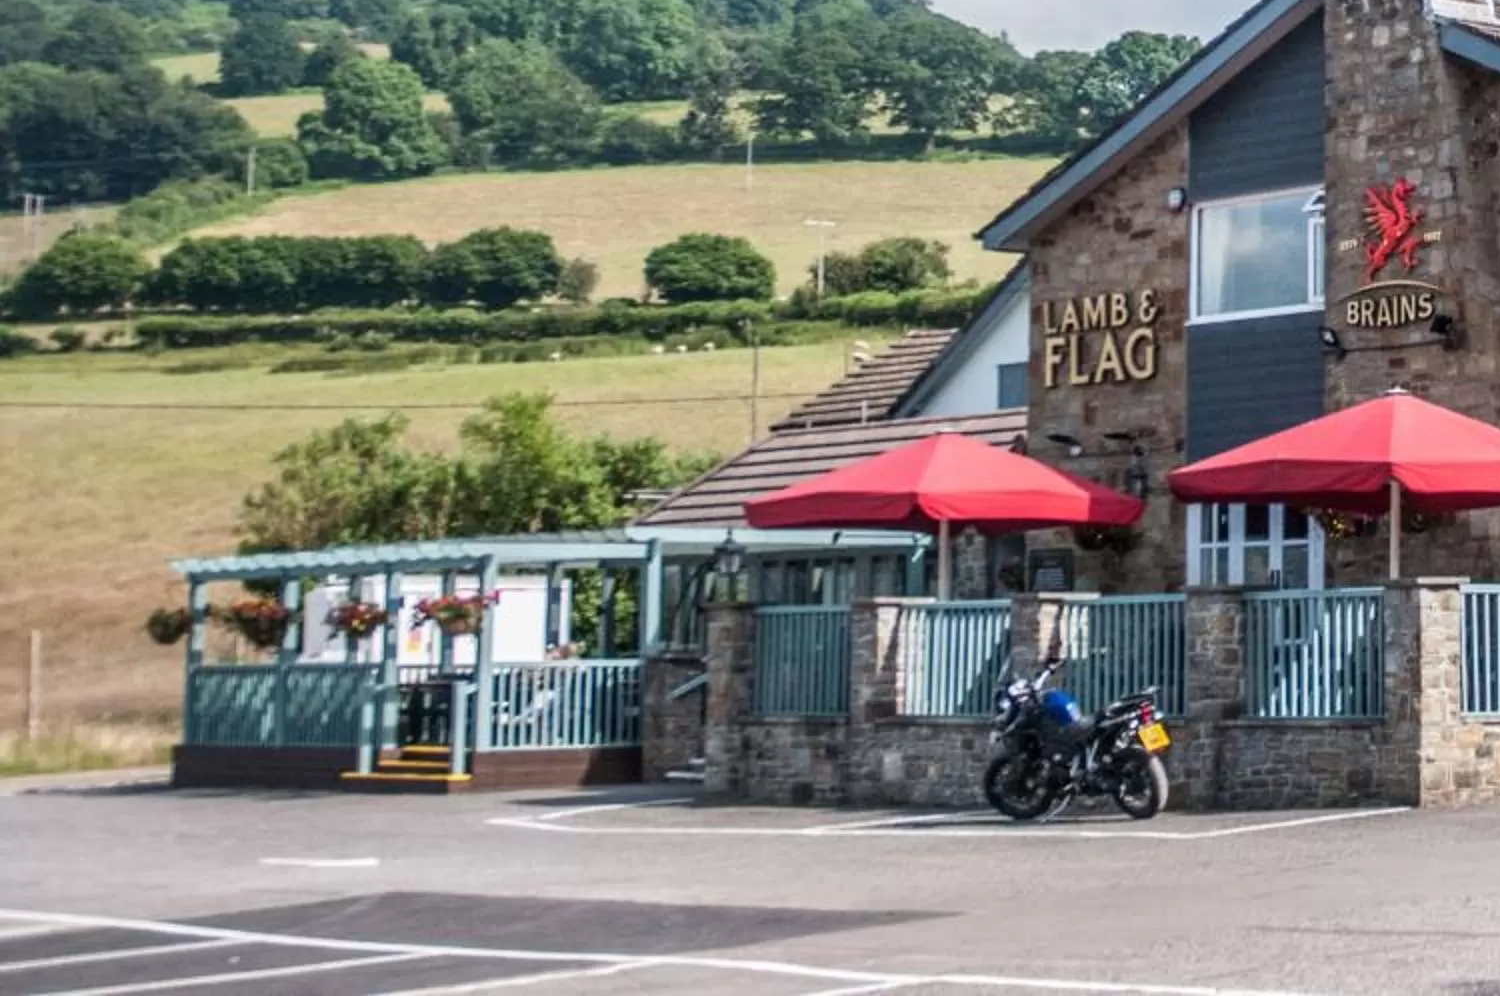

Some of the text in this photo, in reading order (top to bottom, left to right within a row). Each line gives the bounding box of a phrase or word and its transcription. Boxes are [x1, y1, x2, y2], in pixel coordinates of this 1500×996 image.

[1042, 289, 1156, 334] LAMB &
[1346, 293, 1433, 327] BRAINS
[1044, 327, 1155, 387] FLAG
